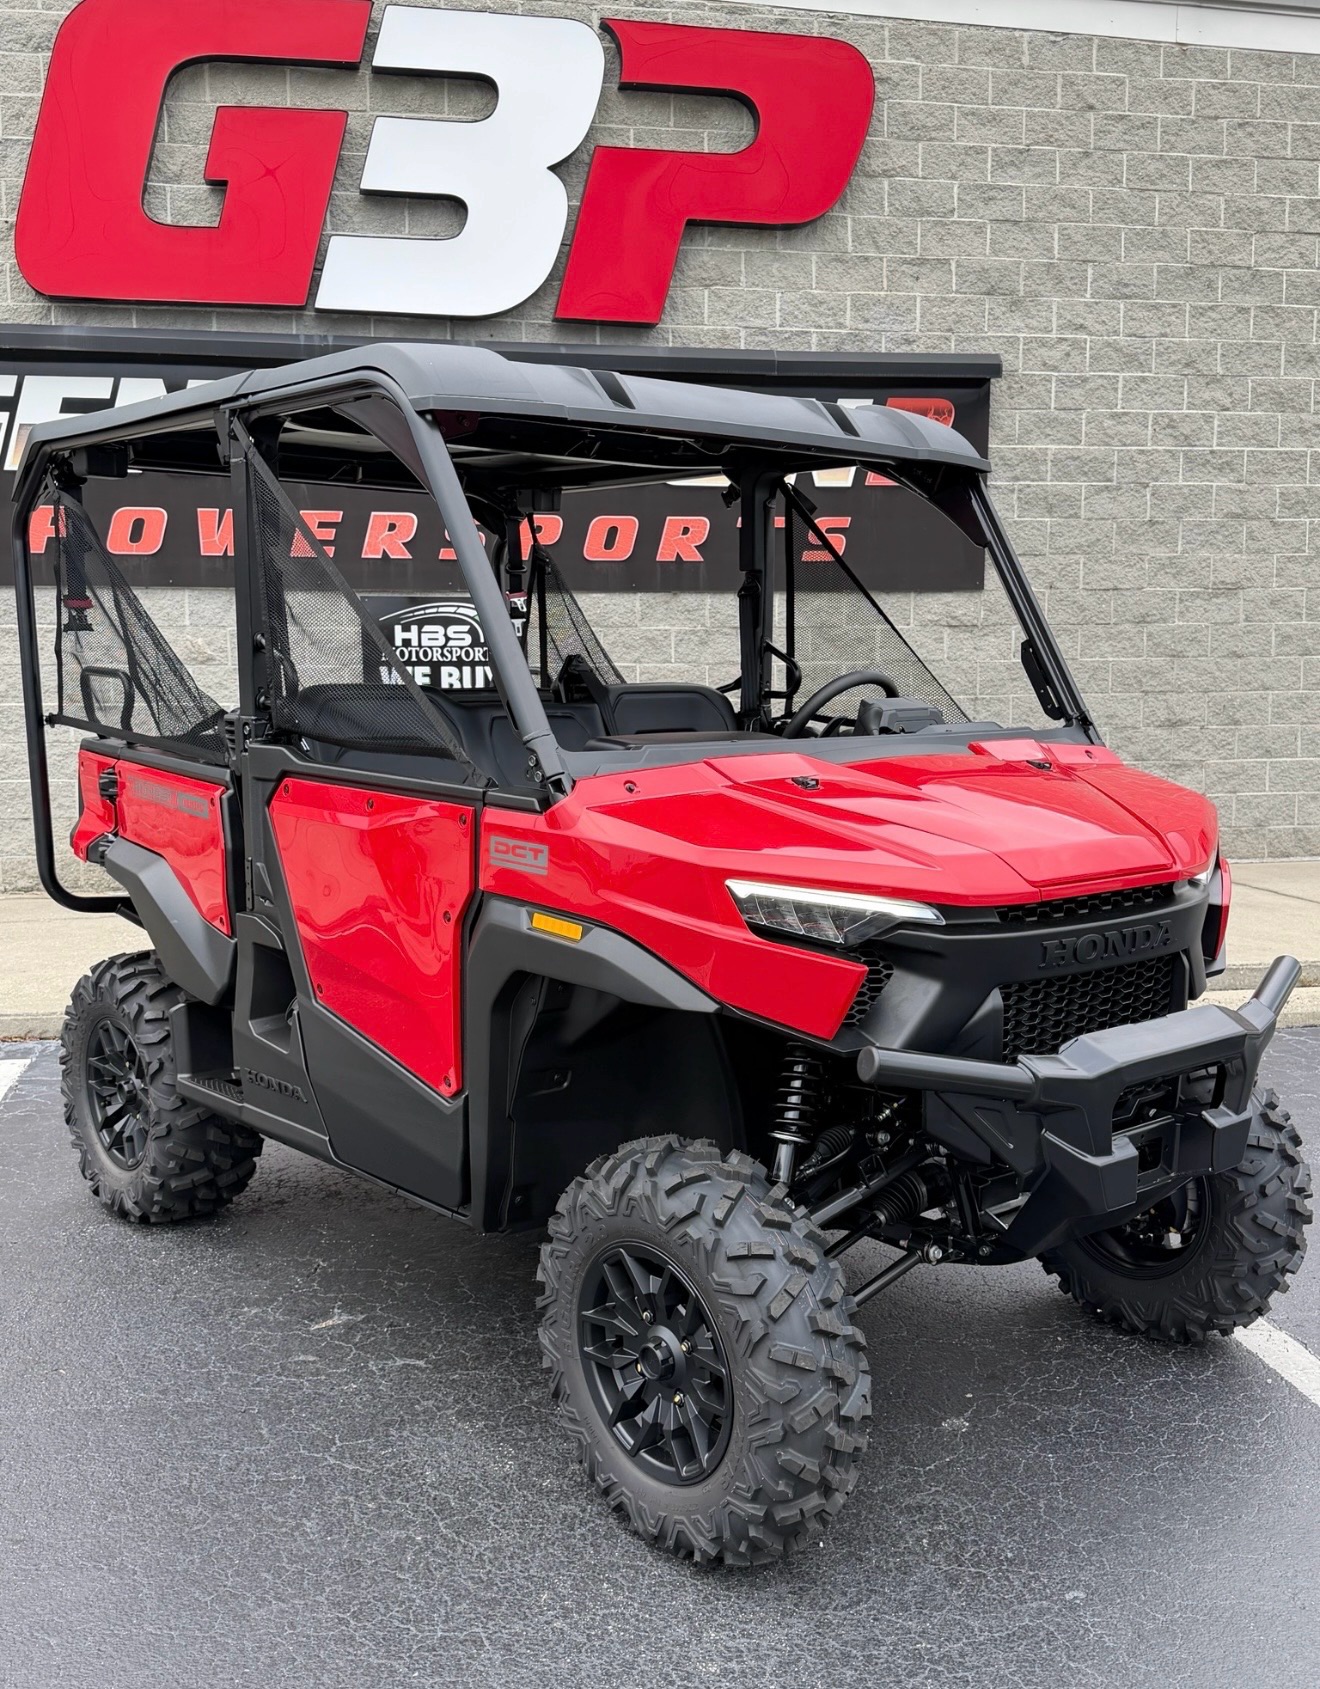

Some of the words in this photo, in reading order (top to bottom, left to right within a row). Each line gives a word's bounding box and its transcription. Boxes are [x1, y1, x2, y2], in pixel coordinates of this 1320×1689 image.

[28, 504, 850, 563] POWERPORS
[395, 625, 472, 647] HBS
[381, 647, 489, 662] OTORSPORT
[493, 839, 544, 861] DCT
[1038, 920, 1176, 968] HONDA
[244, 1067, 308, 1103] HONDA
